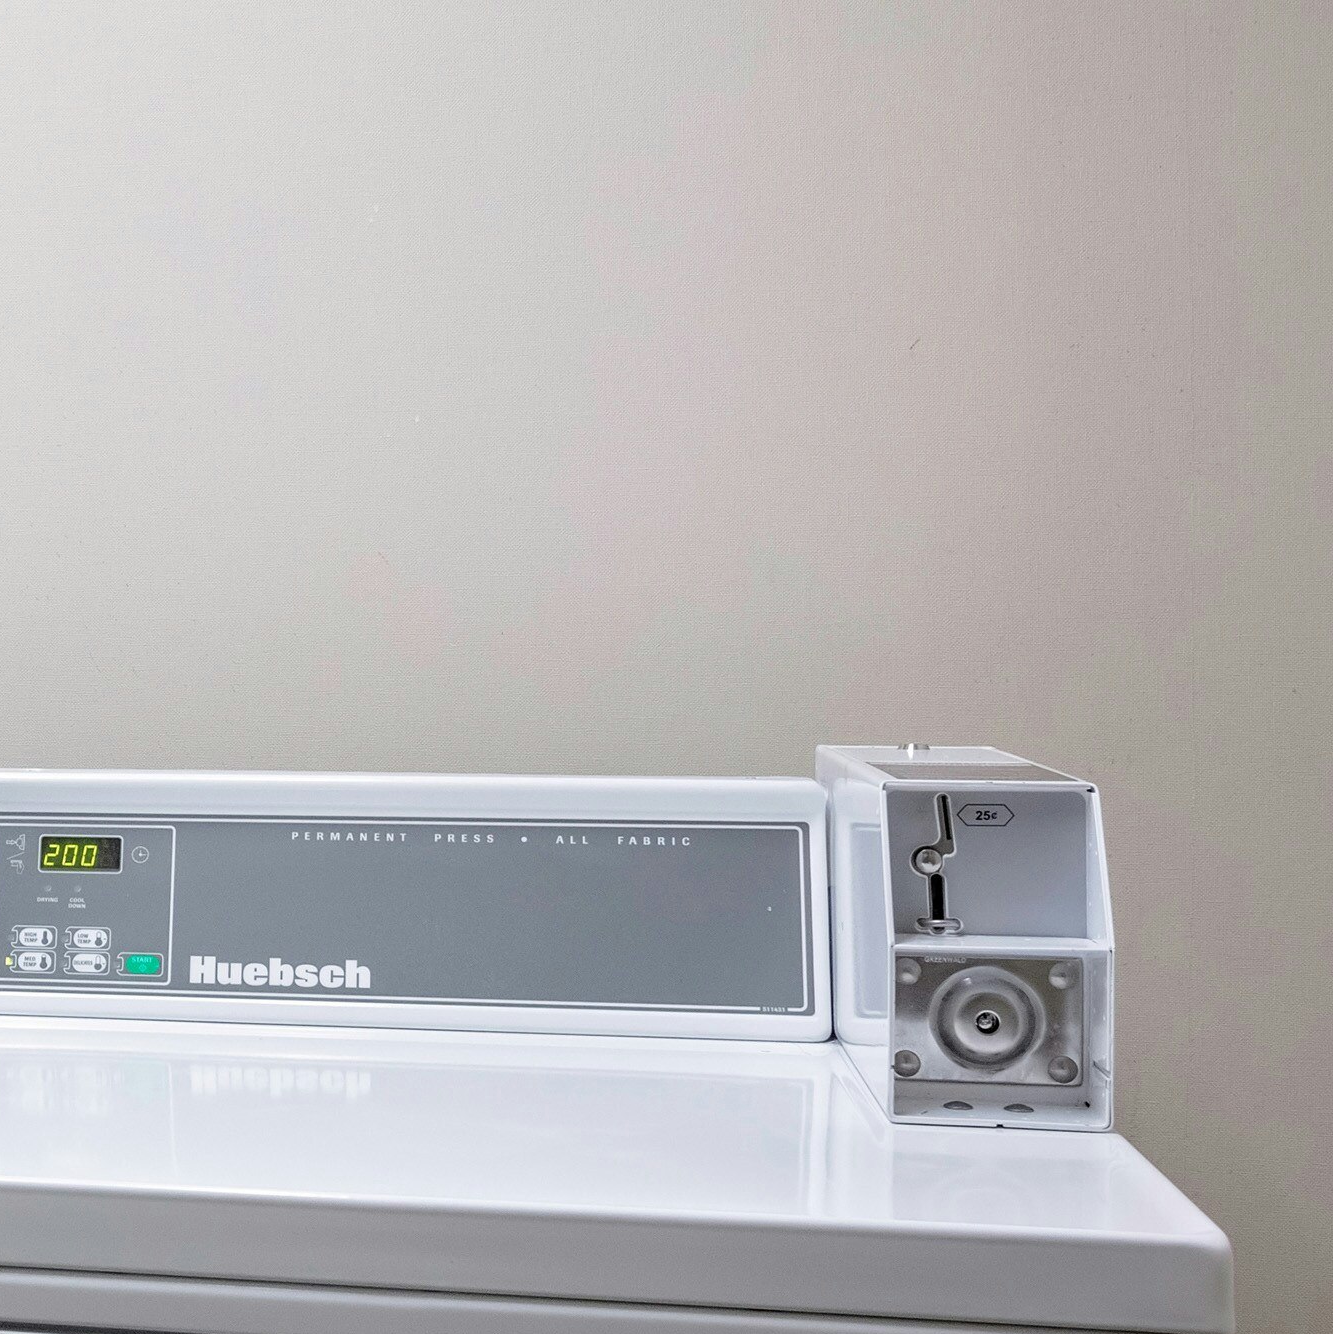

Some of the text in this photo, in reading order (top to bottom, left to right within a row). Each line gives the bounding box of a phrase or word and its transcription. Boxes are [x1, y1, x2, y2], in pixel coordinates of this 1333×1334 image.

[975, 810, 997, 822] 25¢
[292, 832, 690, 846] PERMANENT PRESS ALL FABRIC
[43, 844, 97, 867] 200
[189, 955, 371, 988] Huebsch
